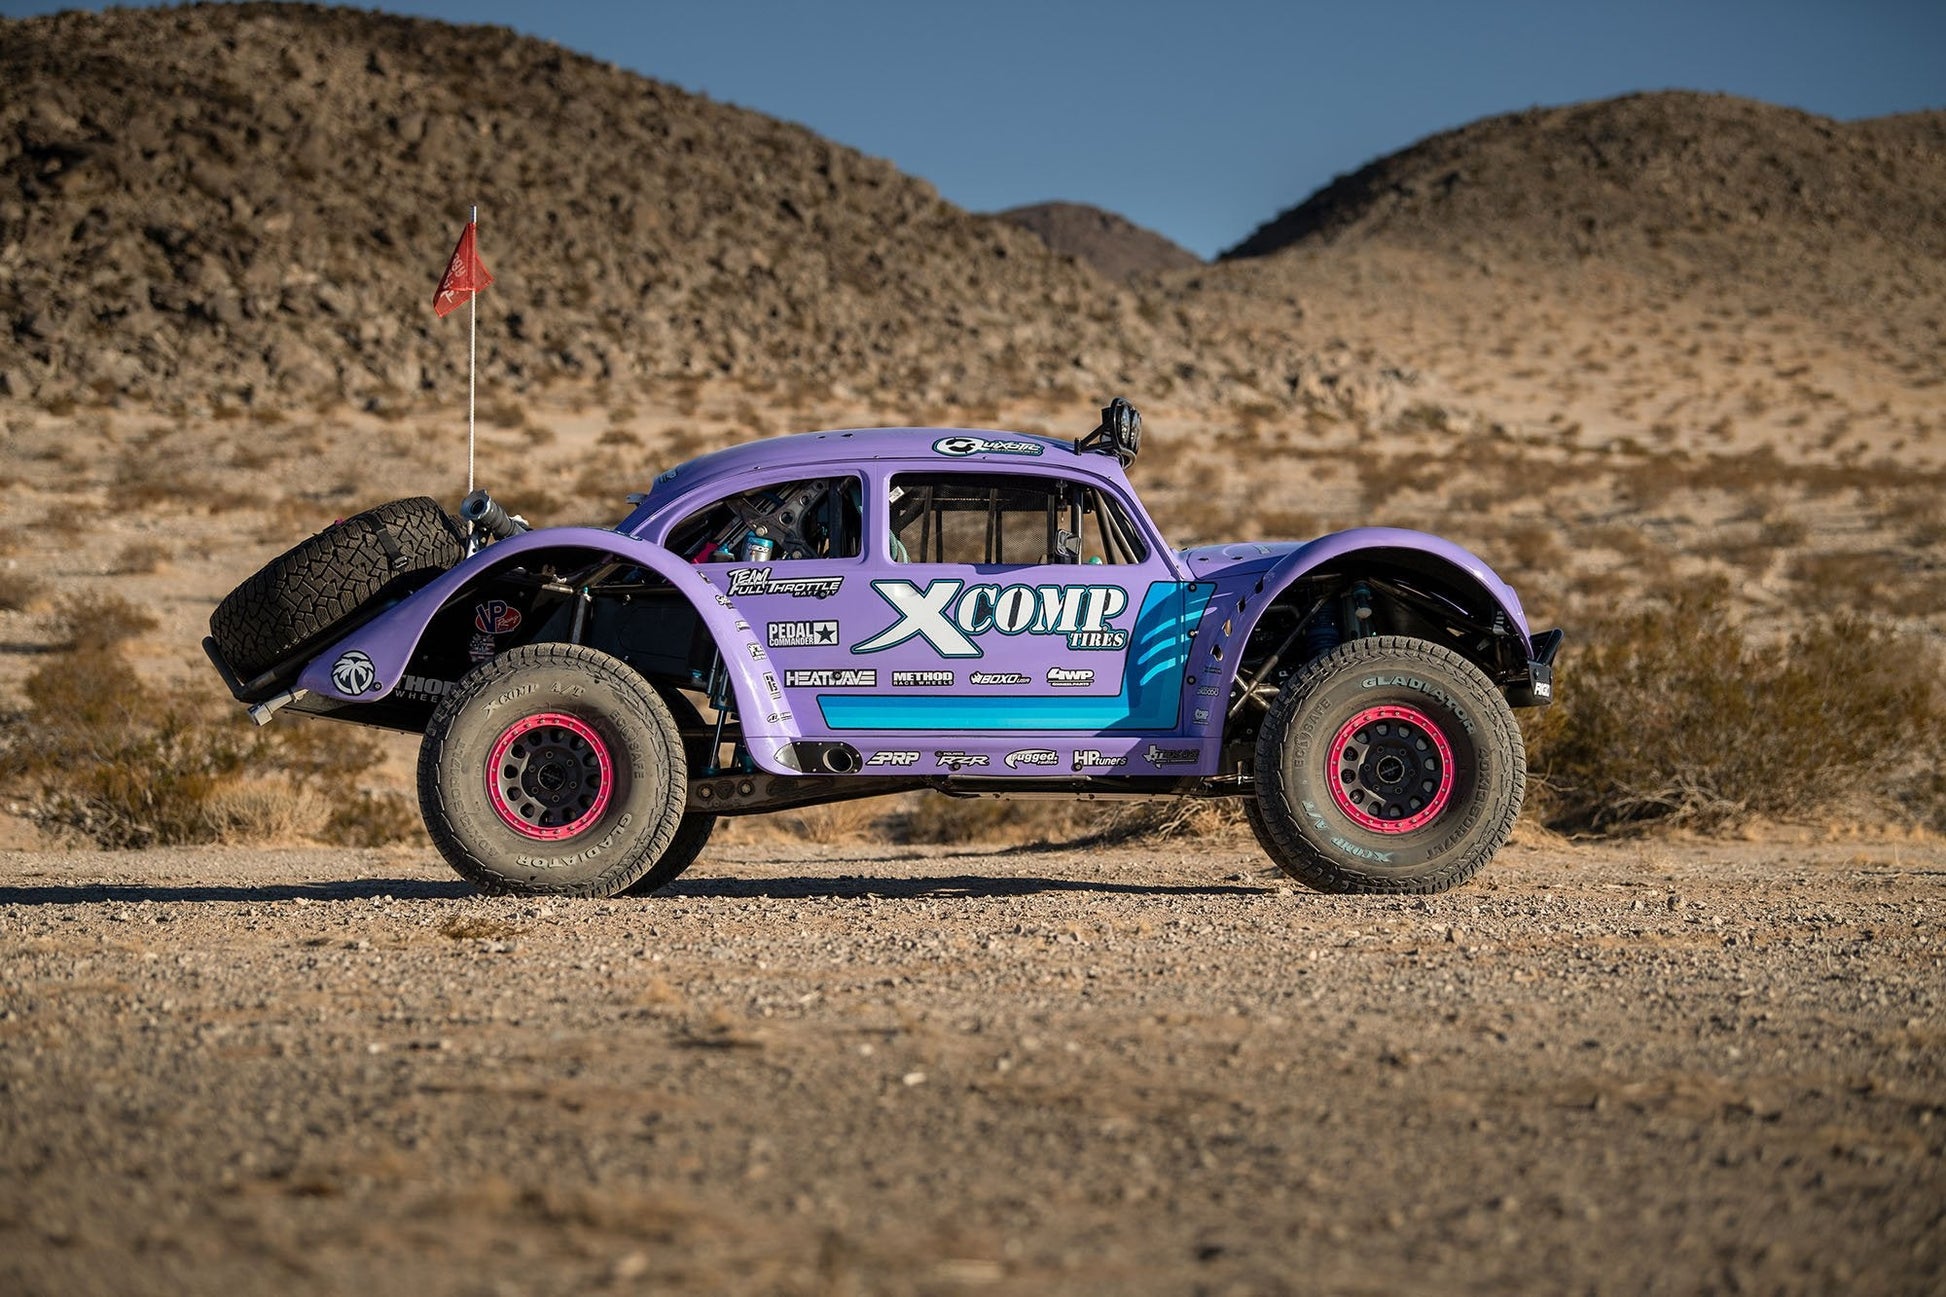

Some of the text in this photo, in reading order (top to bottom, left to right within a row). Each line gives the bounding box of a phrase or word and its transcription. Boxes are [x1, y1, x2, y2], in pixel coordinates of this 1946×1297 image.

[728, 567, 772, 586] TEAM
[728, 577, 842, 595] FULL THROTTLE
[476, 600, 508, 633] VP
[768, 622, 814, 639] PEDAL
[769, 637, 815, 646] COMMANDER
[1069, 631, 1125, 647] TIRES
[893, 672, 953, 681] METHOD
[1046, 667, 1094, 680] 4WP
[395, 689, 440, 703] WHEE
[551, 680, 586, 698] A/T
[1361, 676, 1477, 735] GLADIATOR
[866, 752, 920, 766] PRP
[937, 756, 989, 766] RZR
[516, 813, 633, 870] GLADIATOR
